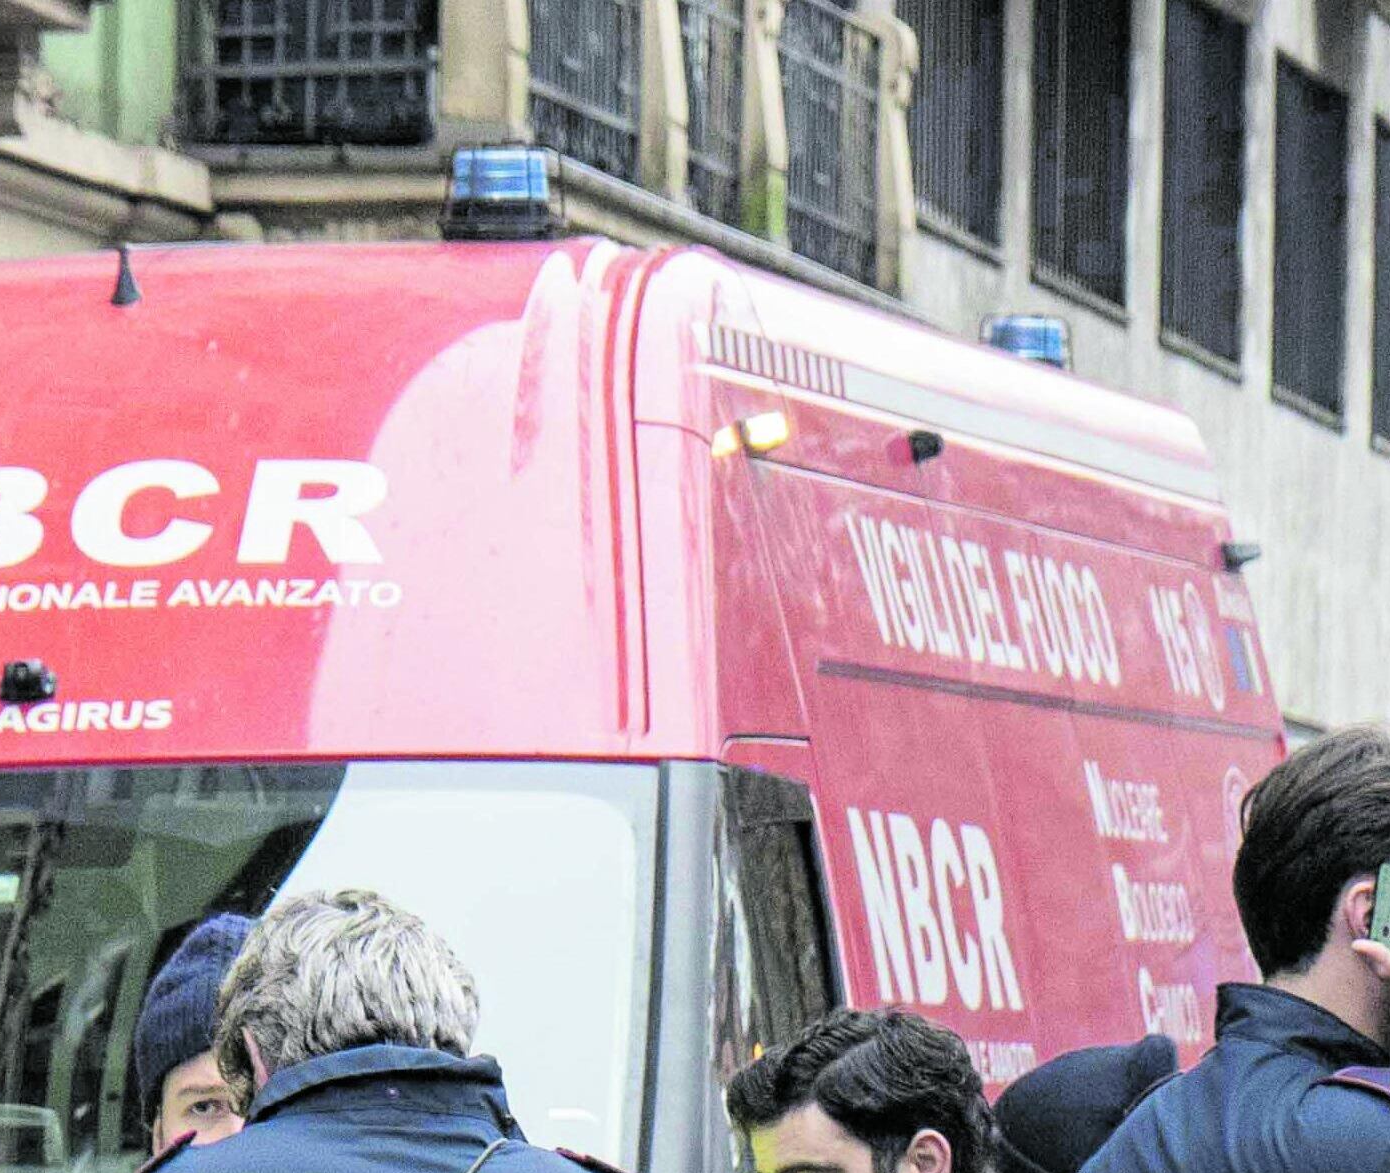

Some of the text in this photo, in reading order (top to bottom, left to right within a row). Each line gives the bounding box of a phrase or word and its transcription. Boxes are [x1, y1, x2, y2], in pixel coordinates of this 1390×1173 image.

[166, 578, 404, 609] AVANZATO
[843, 510, 1122, 688] VIGILI DEL FUOCO
[1148, 584, 1202, 698] 115
[846, 806, 1025, 1011] NBCR
